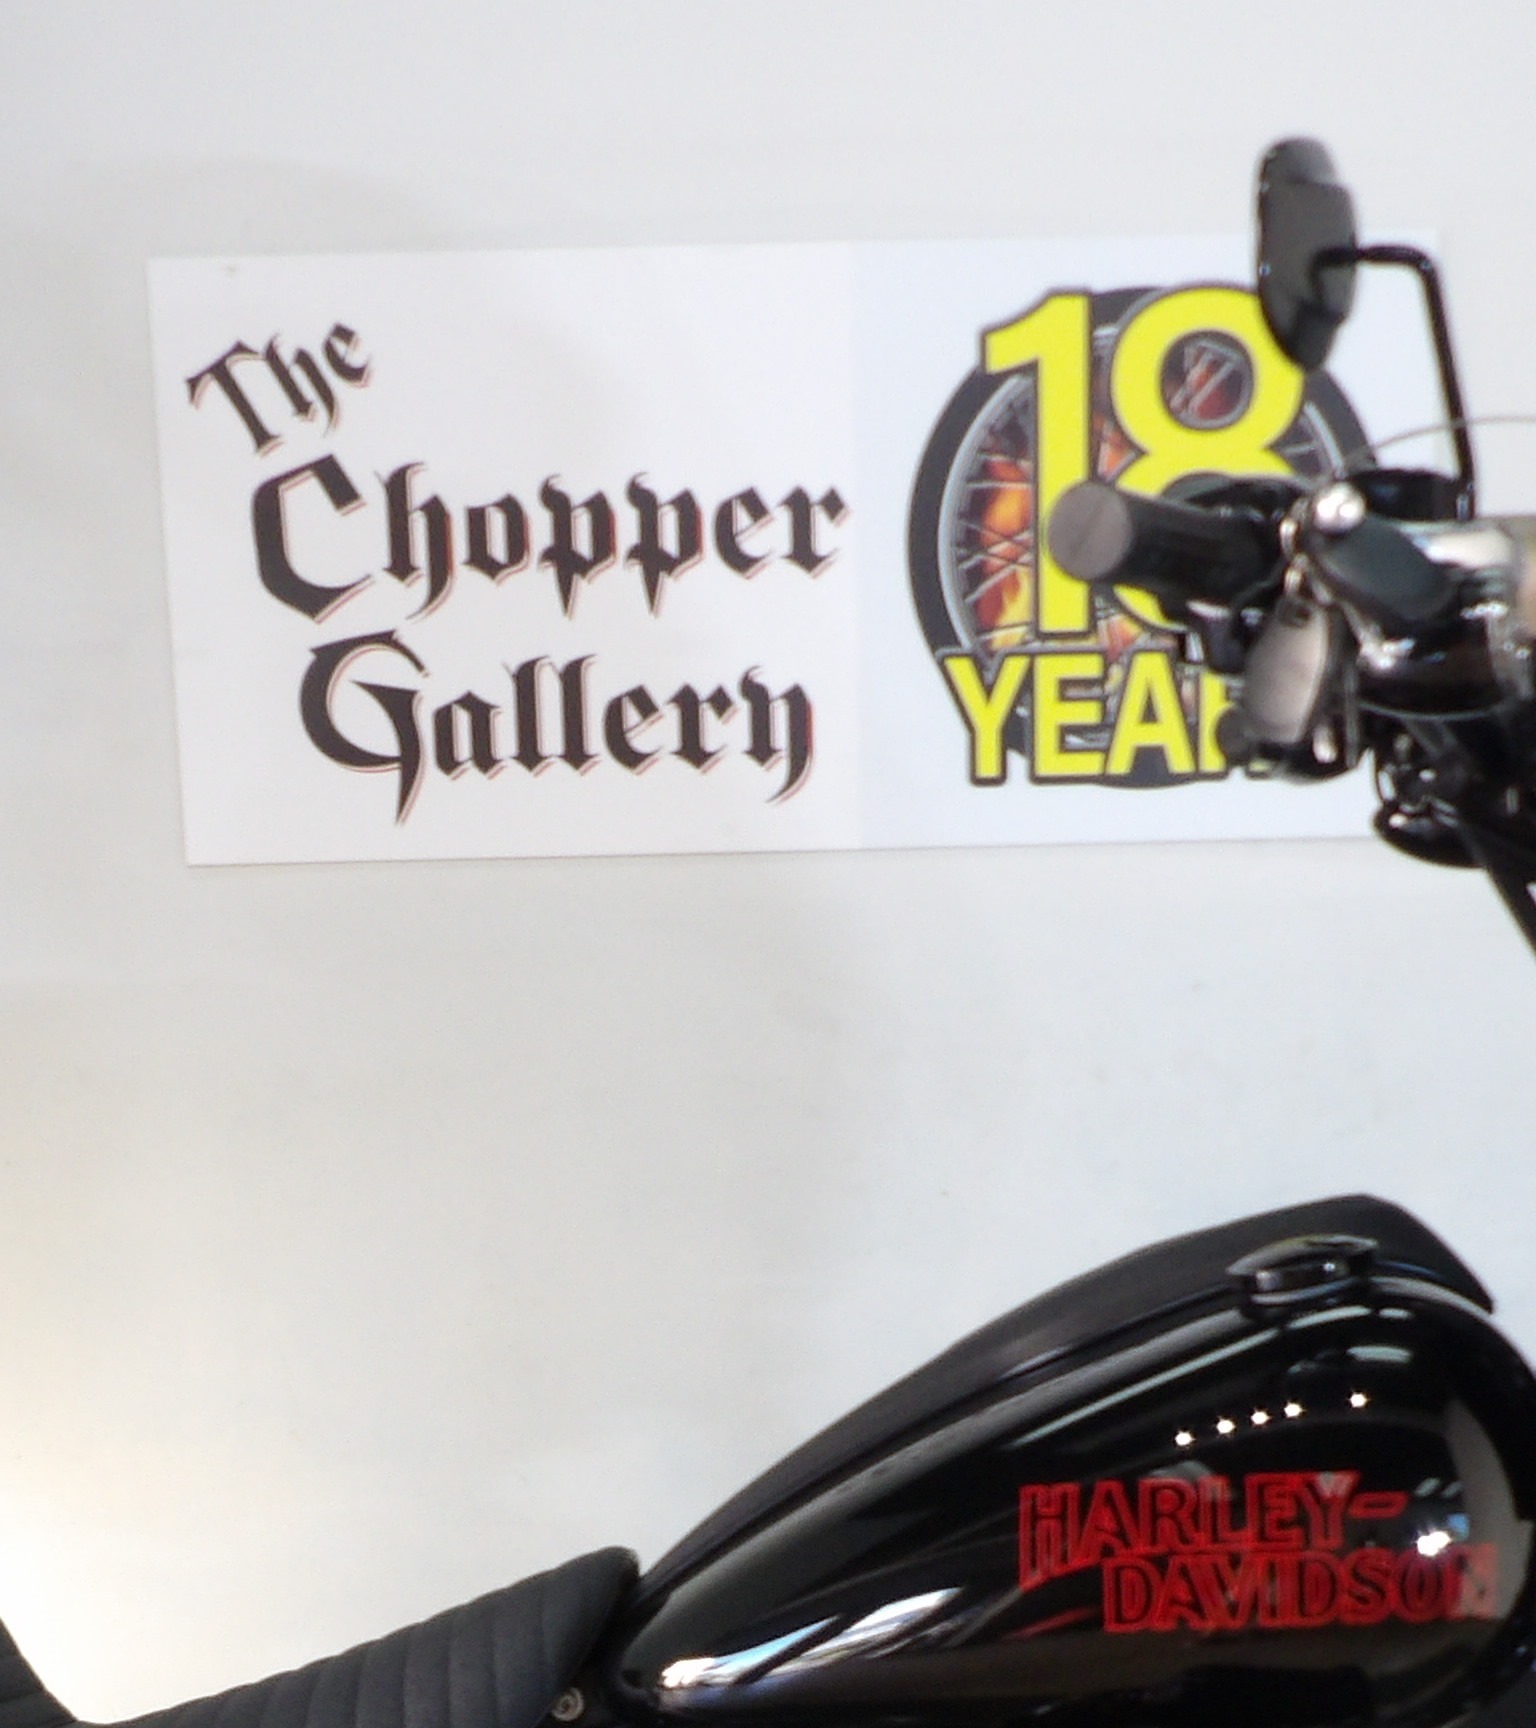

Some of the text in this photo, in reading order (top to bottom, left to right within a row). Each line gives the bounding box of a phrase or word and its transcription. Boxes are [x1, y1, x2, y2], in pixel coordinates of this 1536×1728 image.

[183, 321, 373, 457] The
[250, 453, 852, 624] Chopper
[298, 628, 815, 827] Gallery
[1018, 1470, 1409, 1594] HARLEY-
[1102, 1542, 1498, 1634] DAVIDSON
